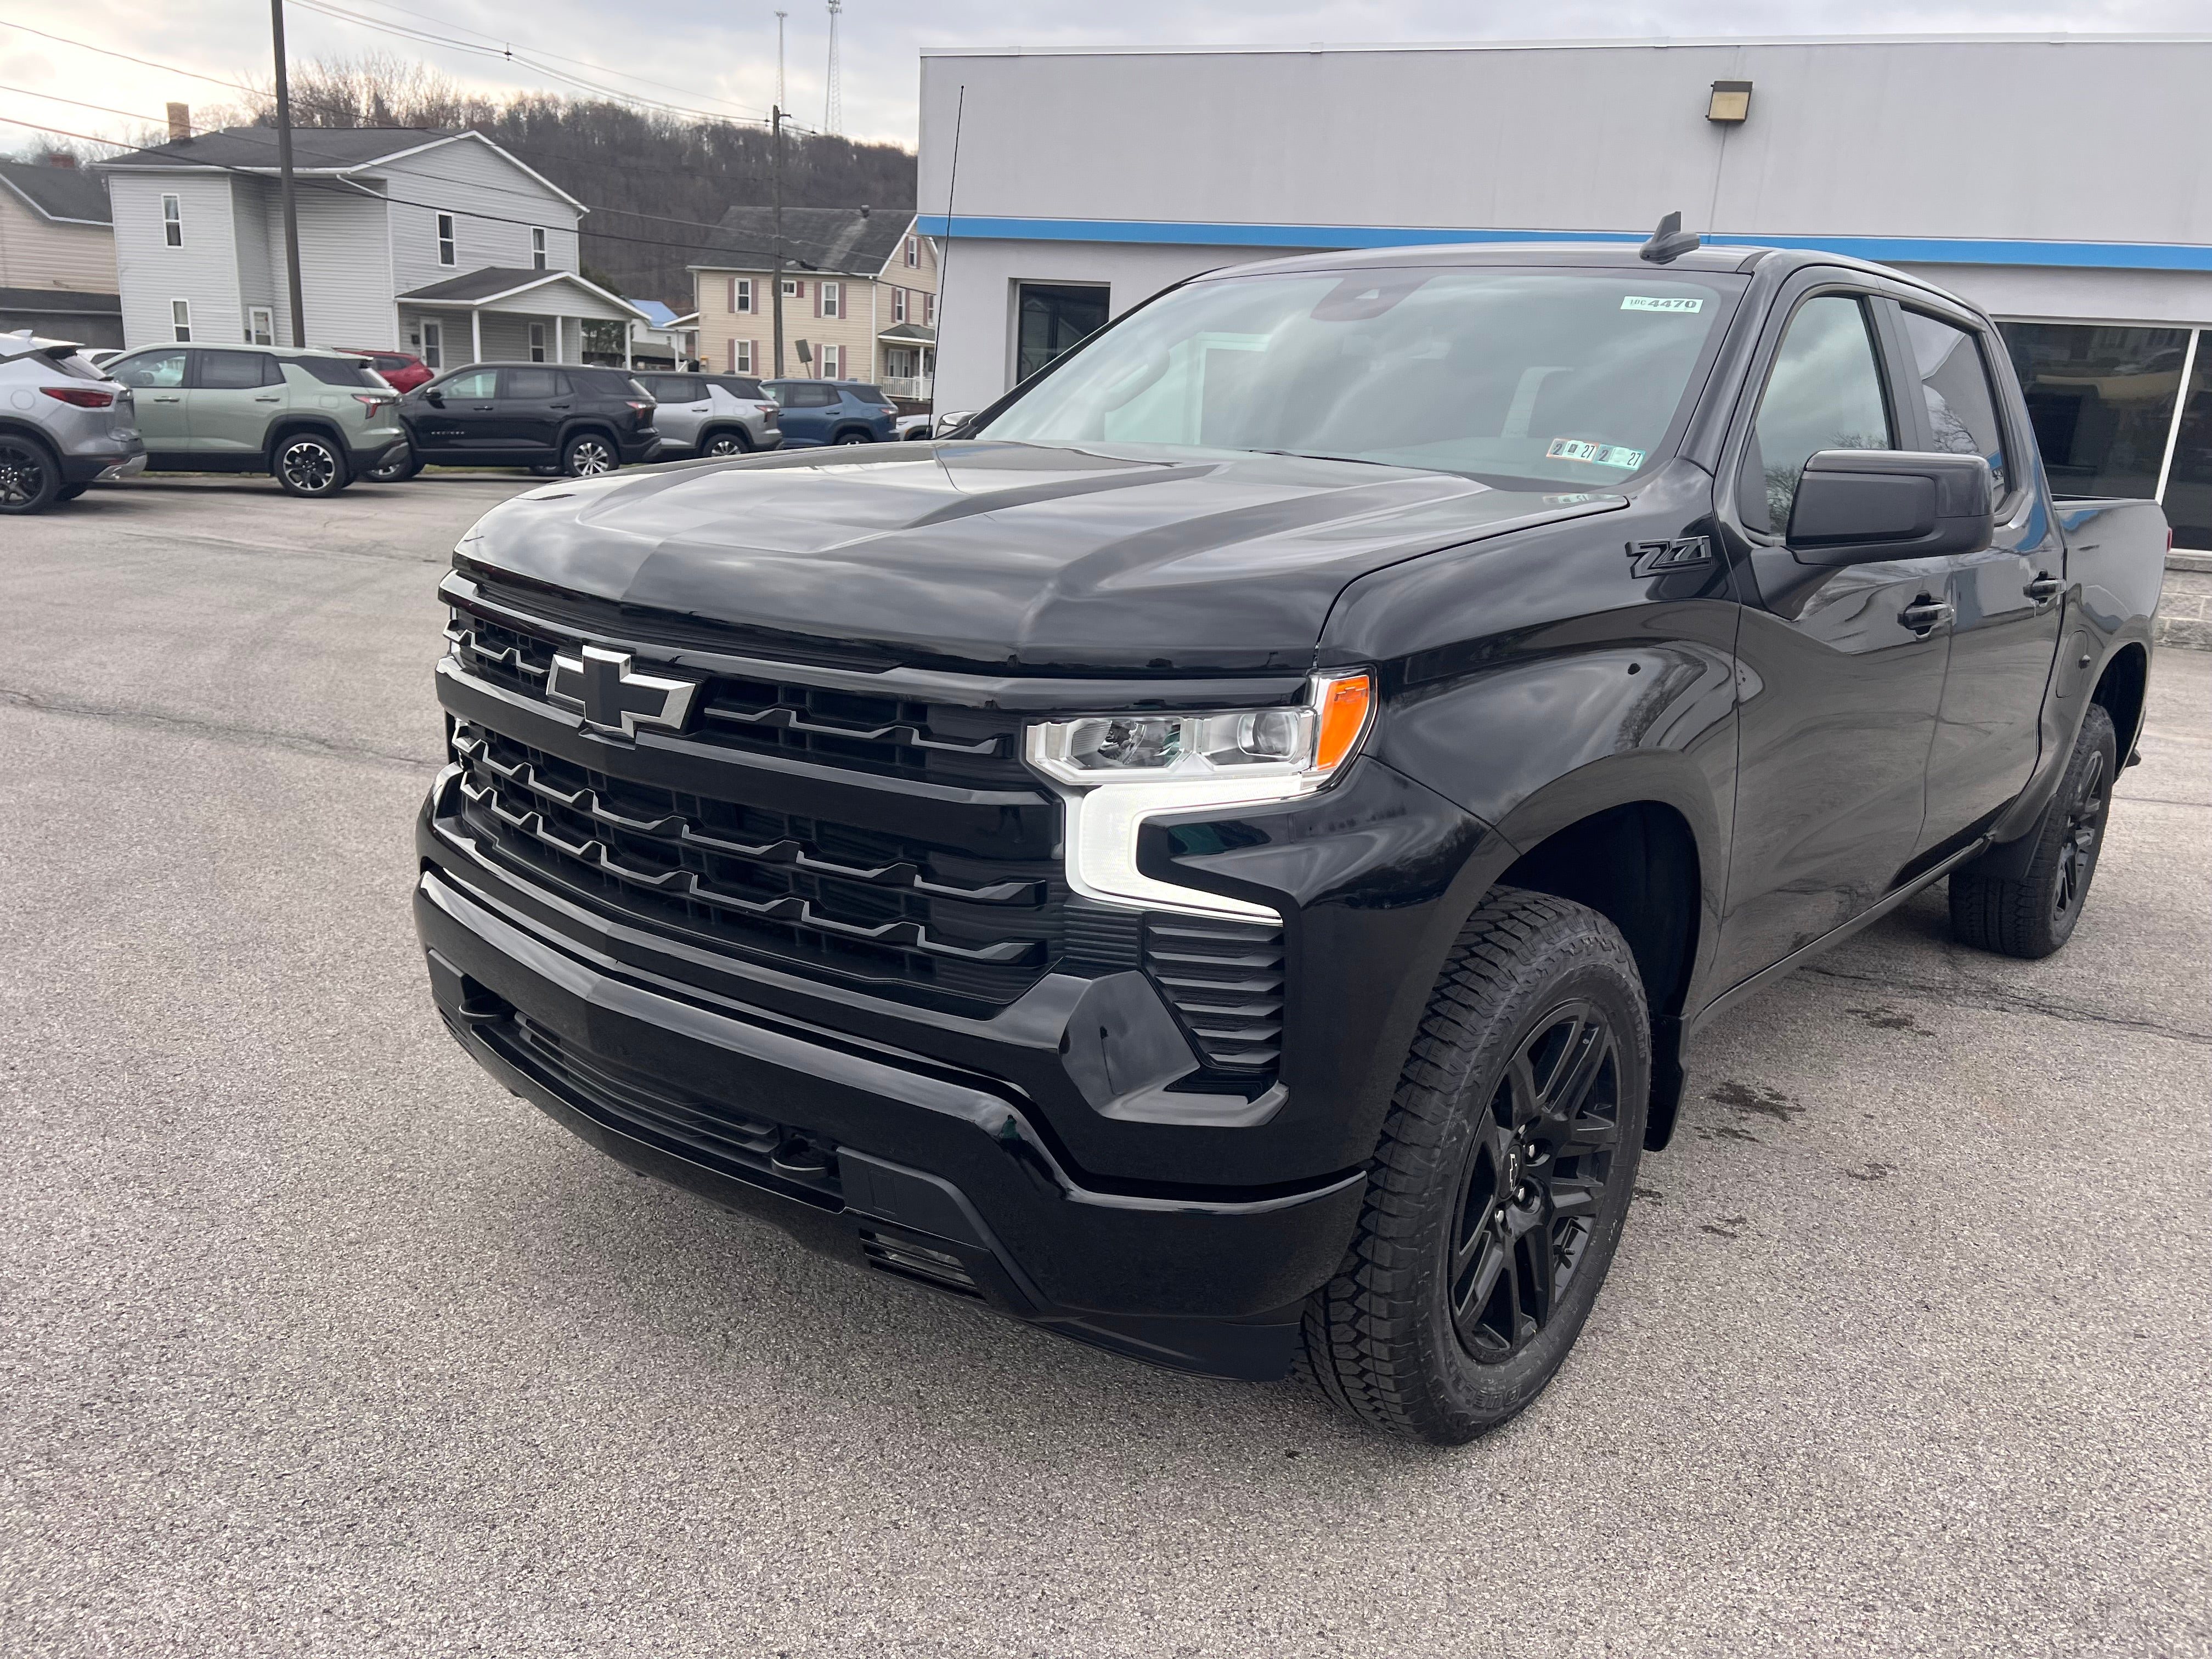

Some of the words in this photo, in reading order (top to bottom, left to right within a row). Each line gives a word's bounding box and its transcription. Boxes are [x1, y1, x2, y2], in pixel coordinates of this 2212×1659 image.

[1647, 300, 1697, 308] 4470
[1553, 443, 1563, 456] 2
[1581, 444, 1595, 459] 27
[1598, 449, 1609, 462] 2
[1627, 452, 1641, 466] 27
[1625, 534, 1714, 579] Z71
